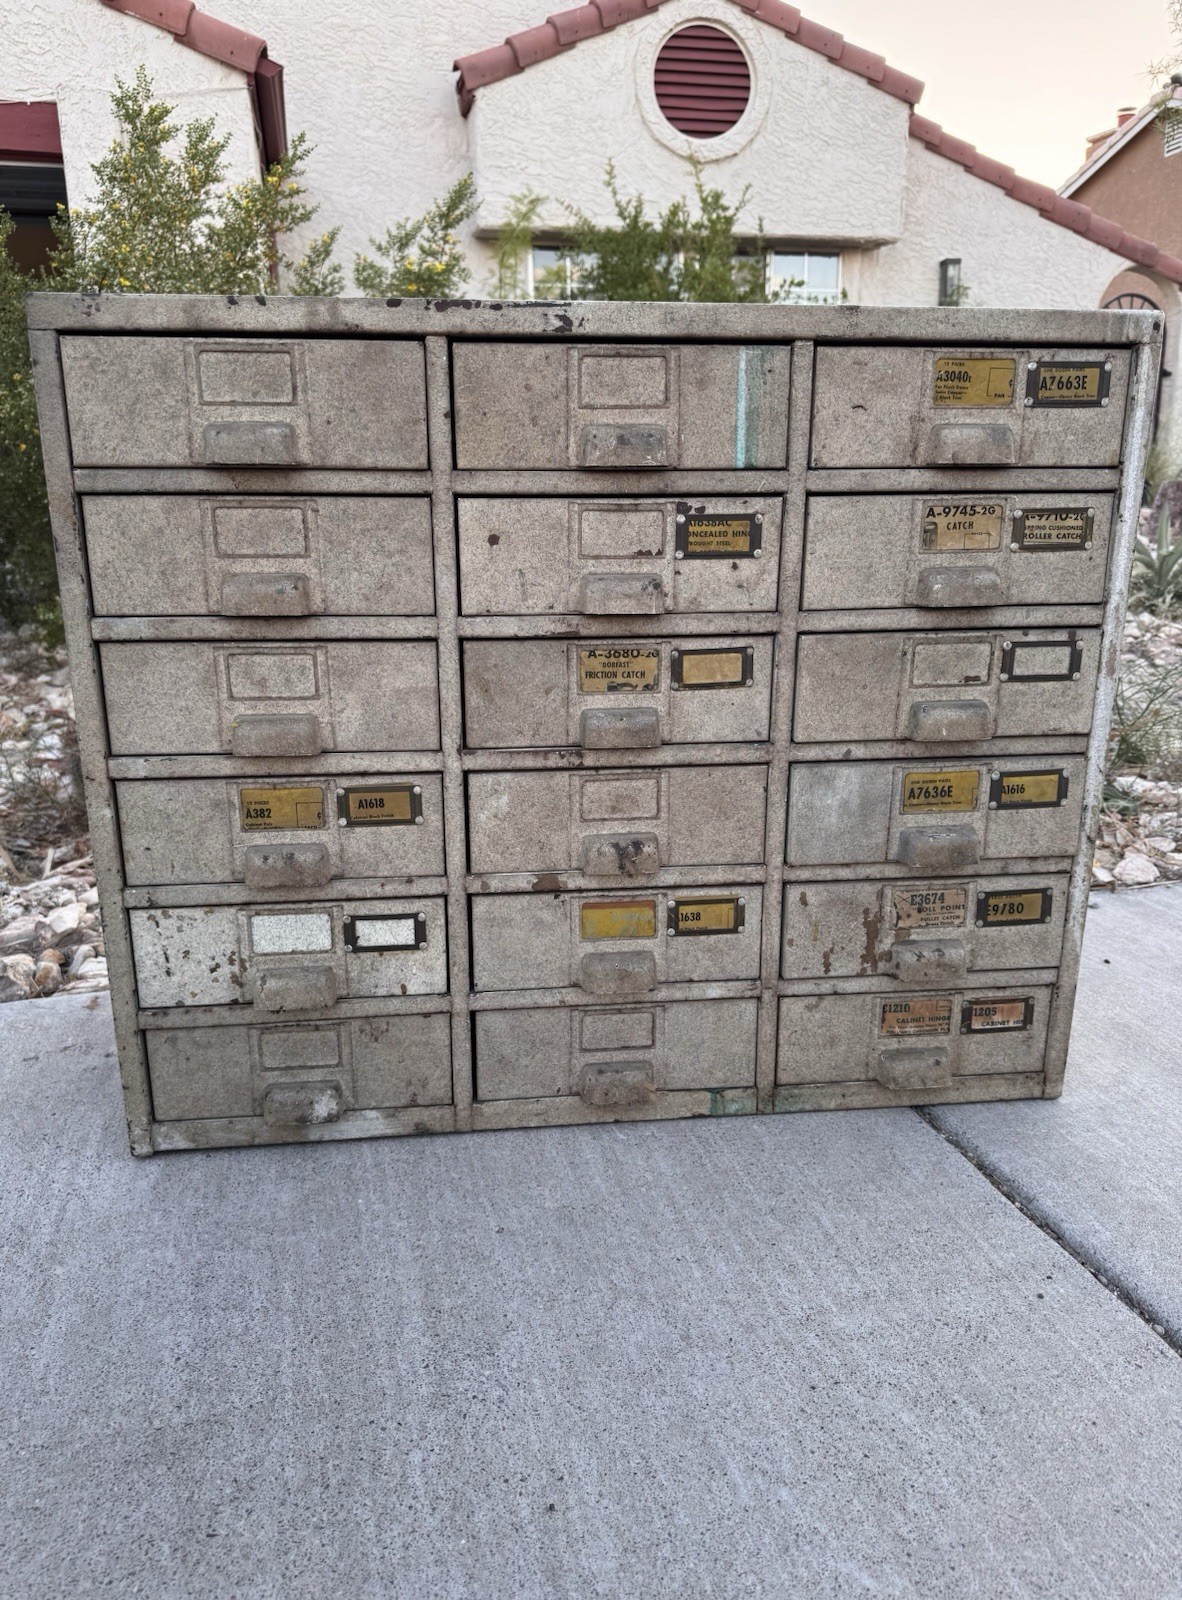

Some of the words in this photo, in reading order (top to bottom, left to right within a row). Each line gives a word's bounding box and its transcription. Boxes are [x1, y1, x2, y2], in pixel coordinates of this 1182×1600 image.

[1040, 375, 1088, 391] A7663E
[926, 505, 996, 519] A-9745-2G
[946, 521, 974, 531] CATCH
[1024, 532, 1052, 540] ROLLER
[1056, 532, 1081, 540] CATCH
[585, 670, 618, 679] FRICTION
[621, 670, 646, 679] CATCH
[908, 785, 954, 801] A7636E
[1001, 783, 1026, 795] A1616
[358, 797, 385, 810] A1618
[245, 808, 272, 819] A382
[910, 892, 946, 906] E3674
[679, 911, 701, 922] 1638
